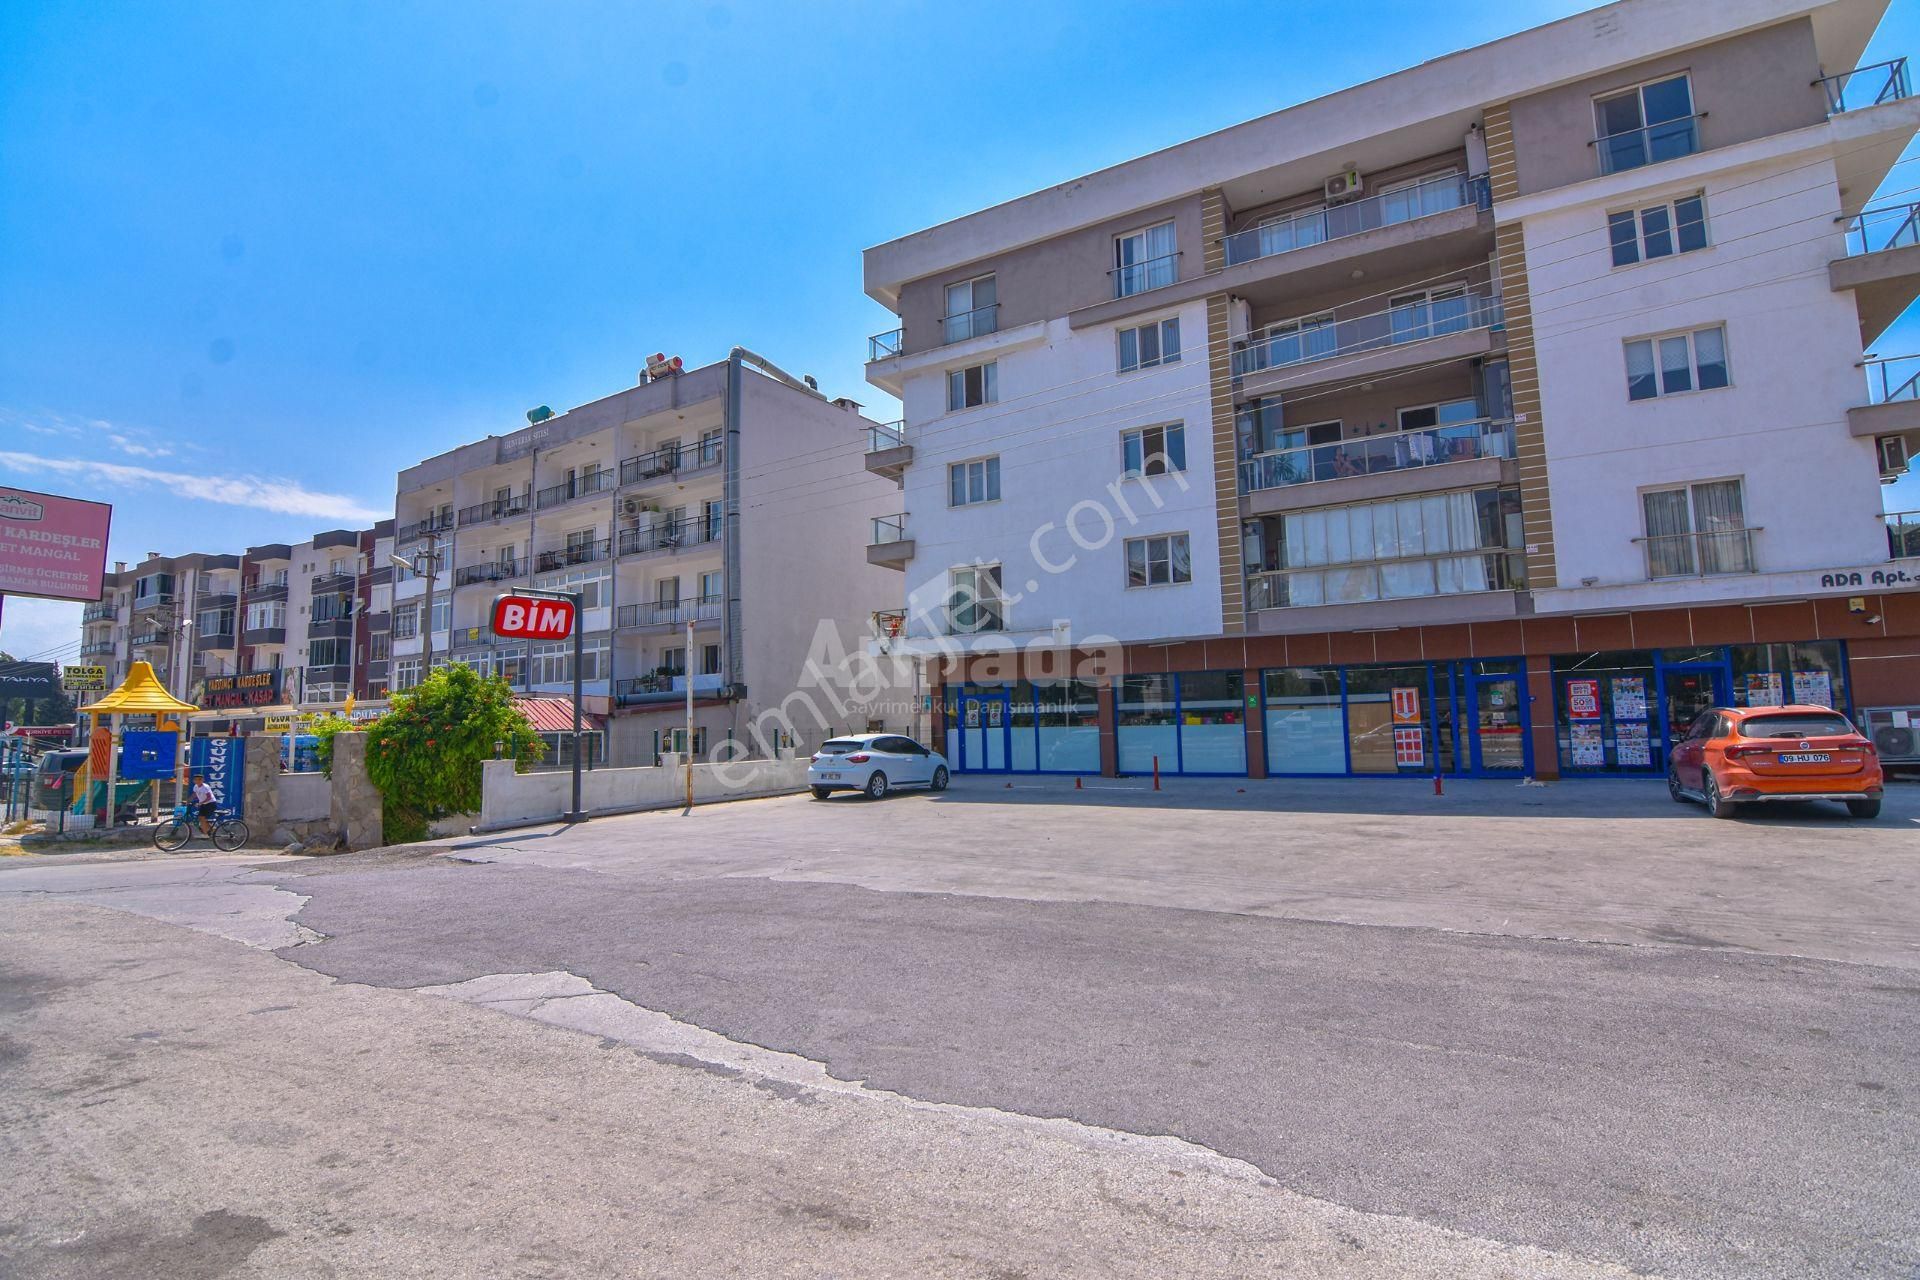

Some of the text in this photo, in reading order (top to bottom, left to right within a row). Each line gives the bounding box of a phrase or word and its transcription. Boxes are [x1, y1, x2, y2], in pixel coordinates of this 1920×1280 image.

[0, 503, 38, 517] anvit
[4, 526, 101, 548] KARDEŞLER
[20, 544, 81, 561] MANGAL
[36, 567, 89, 582] ÜCRETSİZ
[1821, 572, 1863, 588] ADA
[1871, 570, 1912, 587] Apt.
[502, 600, 567, 633] BİM
[1797, 754, 1810, 762] HU
